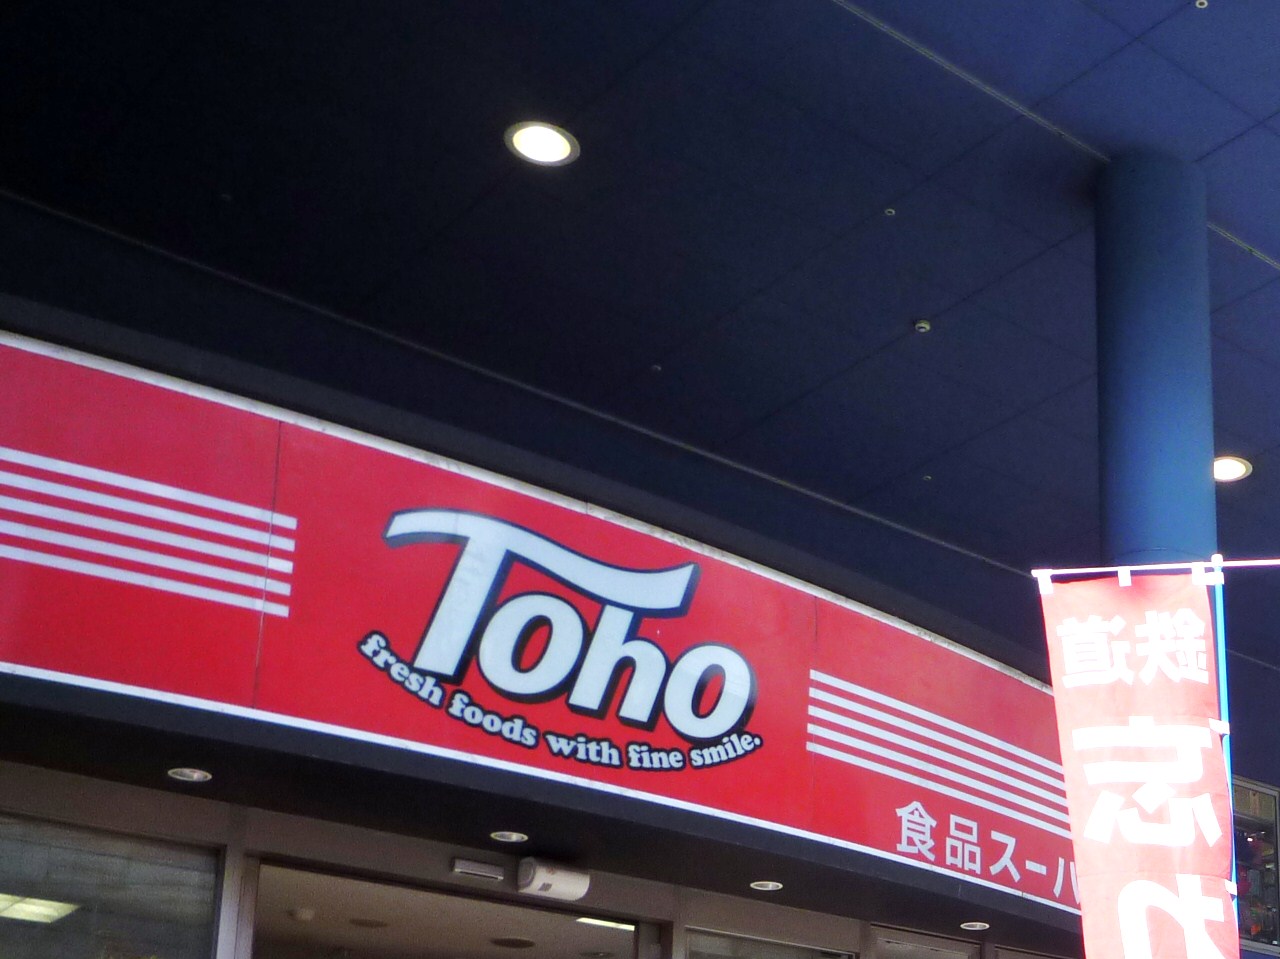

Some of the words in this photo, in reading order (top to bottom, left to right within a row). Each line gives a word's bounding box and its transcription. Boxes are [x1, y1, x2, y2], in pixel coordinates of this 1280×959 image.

[358, 632, 445, 708] fresh
[447, 691, 539, 746] foods
[545, 732, 622, 768] with
[626, 745, 685, 770] fine
[689, 732, 762, 769] smile.
[384, 507, 757, 743] Toho
